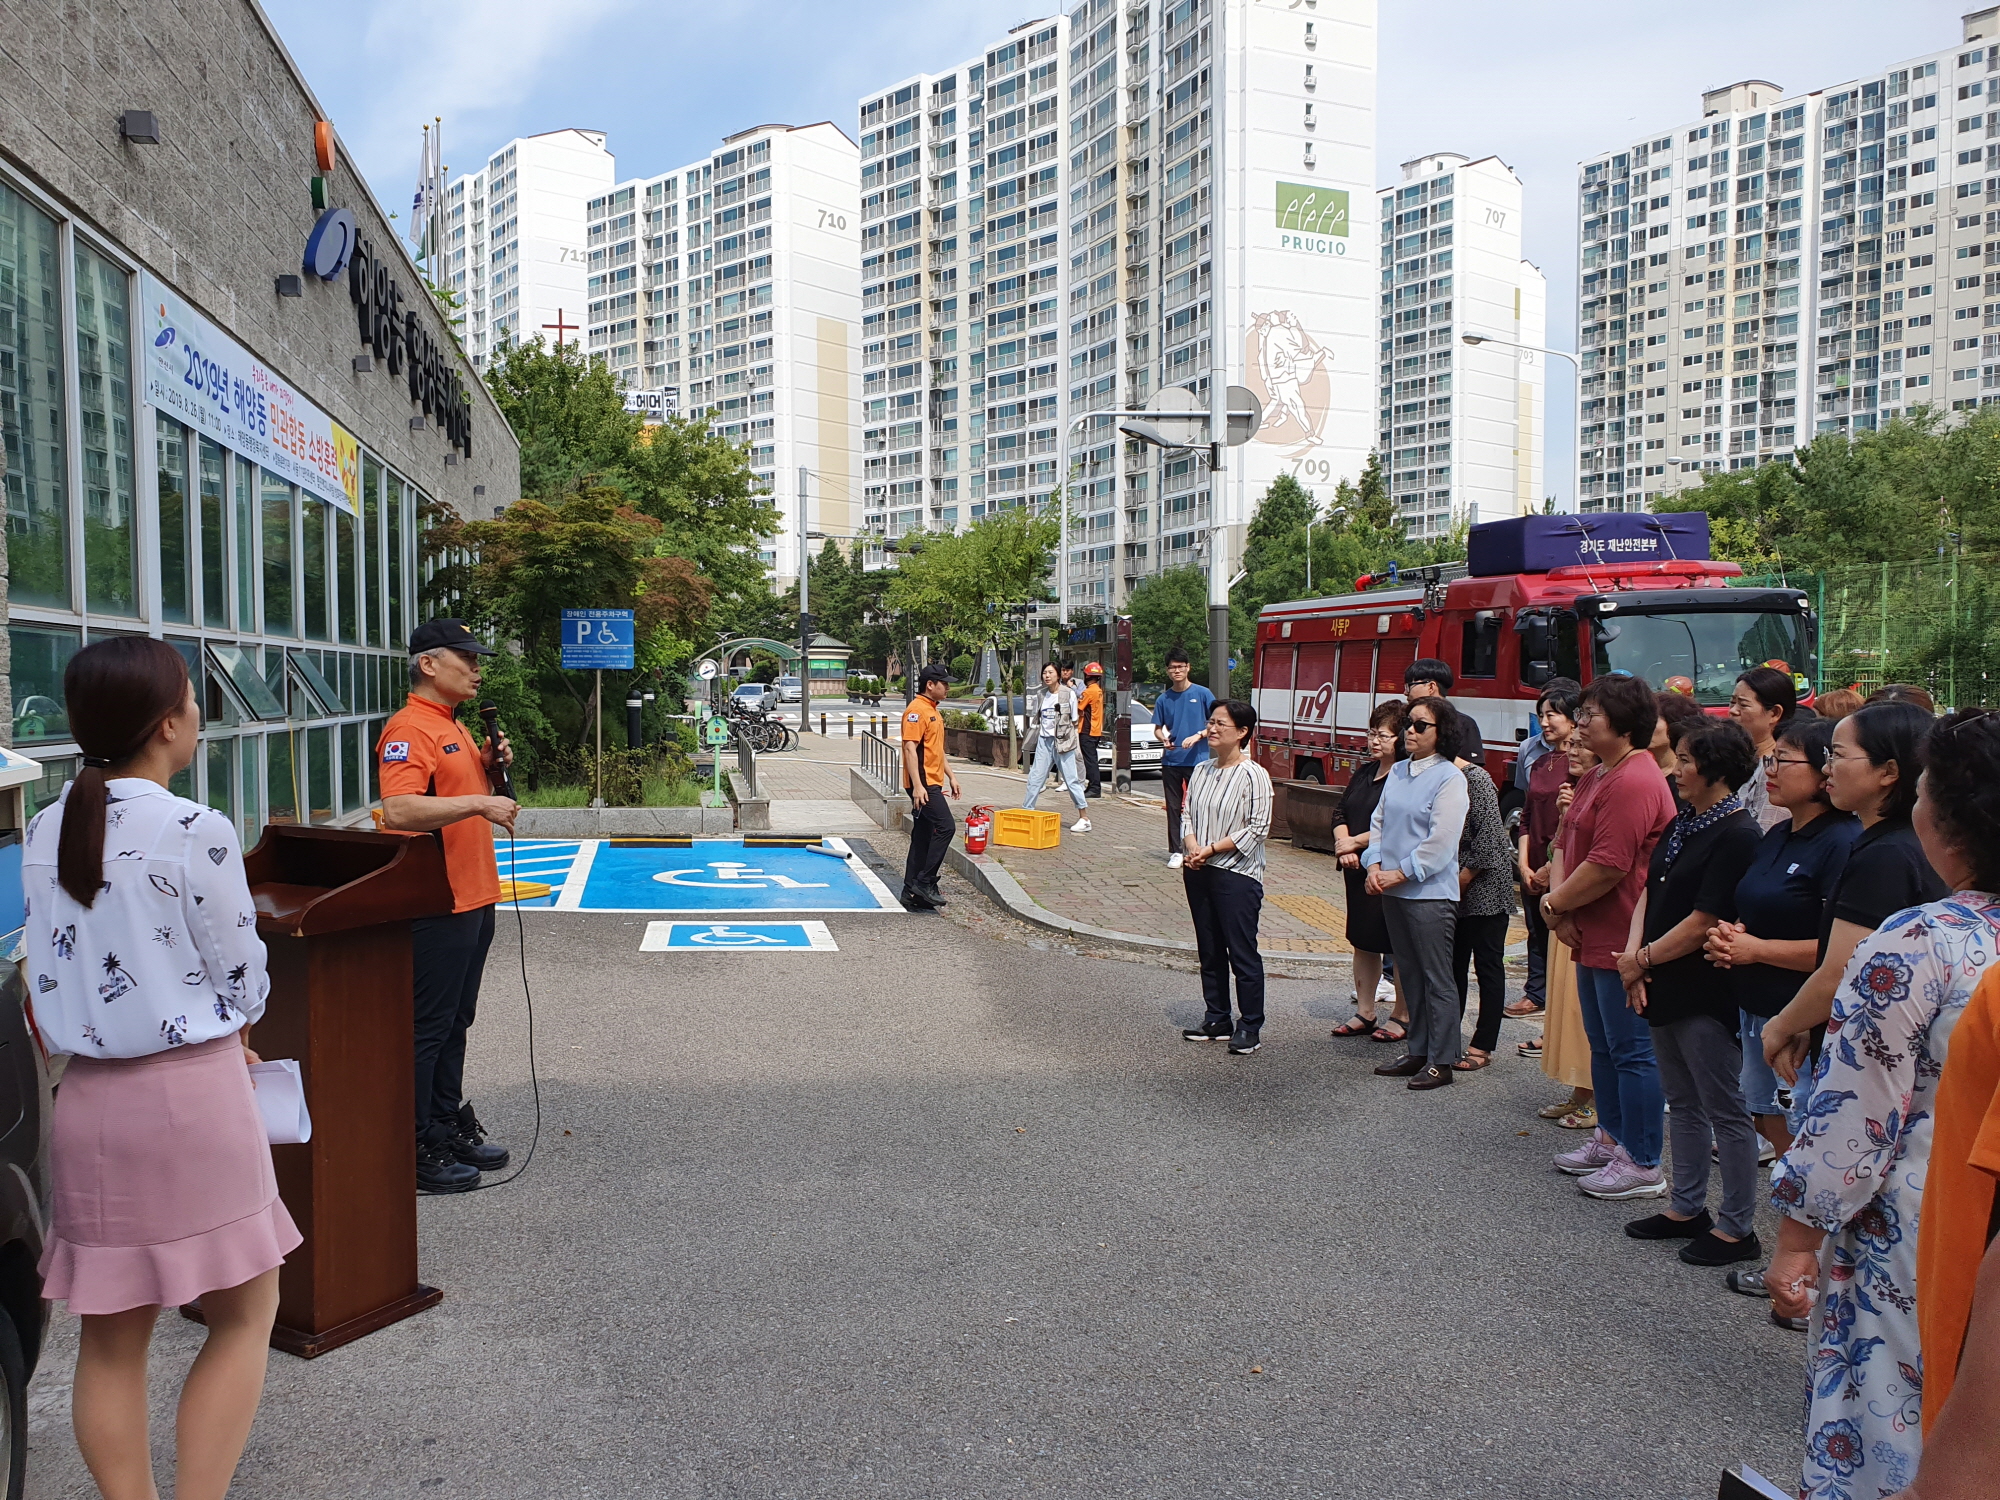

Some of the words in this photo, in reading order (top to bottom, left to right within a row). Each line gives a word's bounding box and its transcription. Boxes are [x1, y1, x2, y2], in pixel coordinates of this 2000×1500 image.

[817, 208, 847, 231] 710
[1485, 207, 1506, 229] 707
[559, 246, 587, 263] 711
[1281, 234, 1346, 256] PRUGIO
[1519, 349, 1534, 364] 703
[184, 344, 230, 414] 2019년
[233, 376, 267, 437] 해양동
[270, 402, 306, 460] 민관합동
[308, 430, 338, 481] 소방훈련
[636, 394, 661, 409] 헤어
[1291, 458, 1331, 483] 709
[1580, 538, 1606, 554] 경기도
[1607, 537, 1658, 553] 재난안전본부
[566, 610, 587, 618] 장애인
[588, 610, 629, 618] 전용주차구역
[577, 620, 592, 645] P
[1330, 618, 1350, 637] 사동P
[1295, 681, 1333, 723] 119
